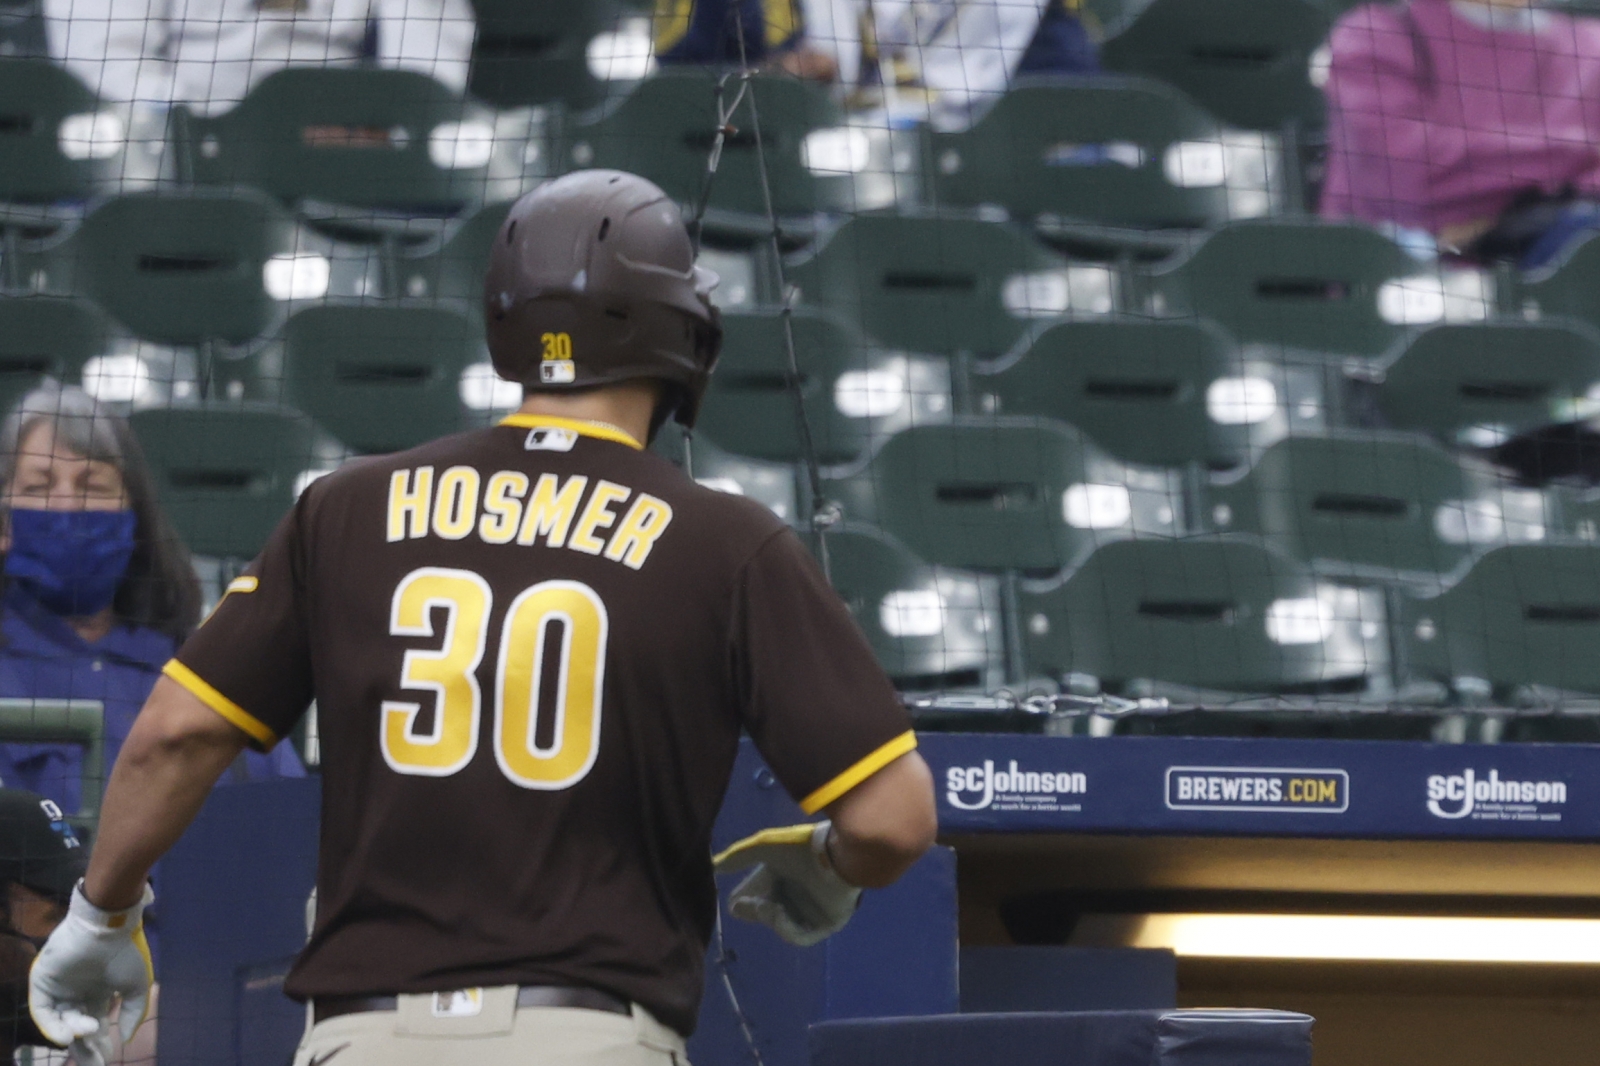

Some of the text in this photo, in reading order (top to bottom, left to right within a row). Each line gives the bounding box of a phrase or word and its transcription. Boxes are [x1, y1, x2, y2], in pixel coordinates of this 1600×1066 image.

[541, 332, 572, 360] 30
[386, 465, 673, 570] HOSMER
[379, 566, 608, 791] 30
[1178, 776, 1337, 803] BREWERS.COM
